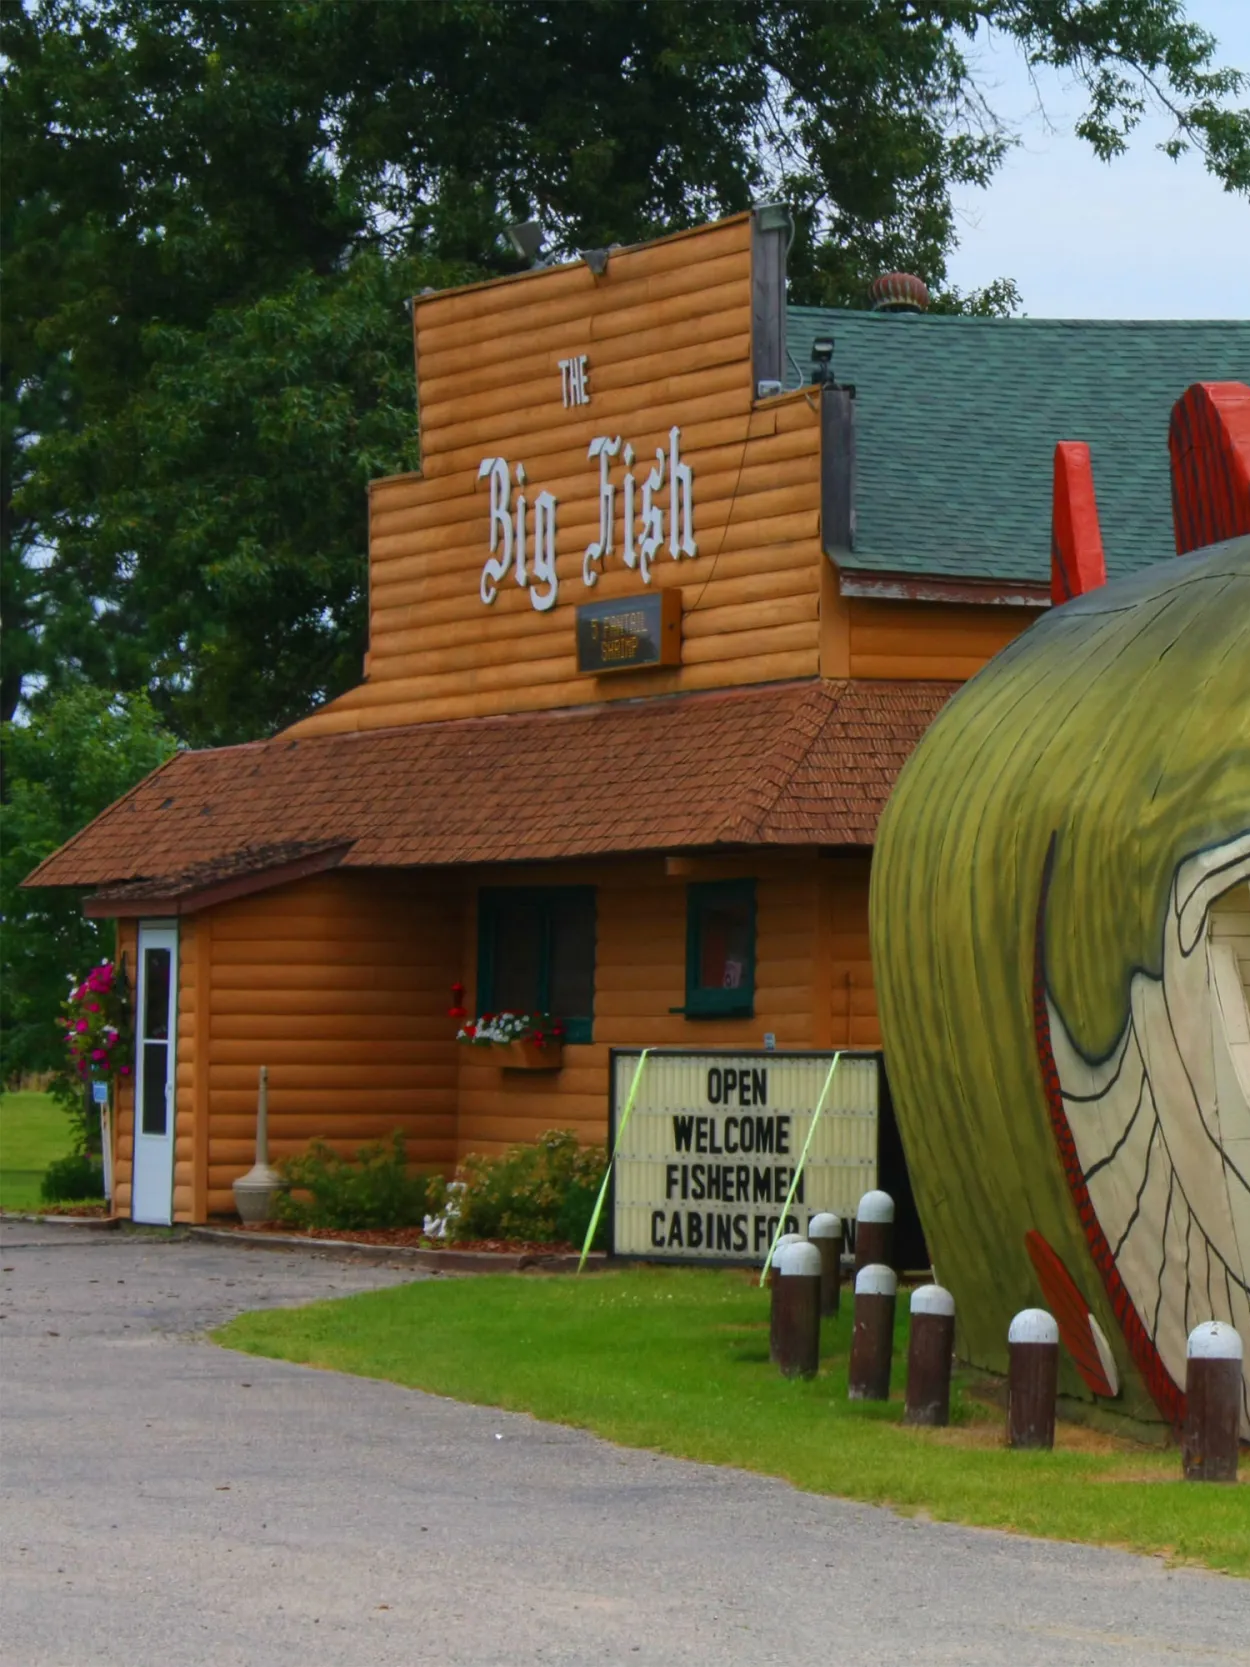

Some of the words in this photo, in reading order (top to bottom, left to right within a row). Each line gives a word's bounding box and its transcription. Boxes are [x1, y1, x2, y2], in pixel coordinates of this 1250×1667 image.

[558, 354, 590, 408] THE
[478, 457, 559, 612] Big
[582, 426, 698, 587] Fish
[707, 1067, 767, 1106] OPEN
[673, 1115, 791, 1154] WELCOME
[666, 1164, 805, 1204] FISHERMEN
[651, 1210, 748, 1251] CABINS
